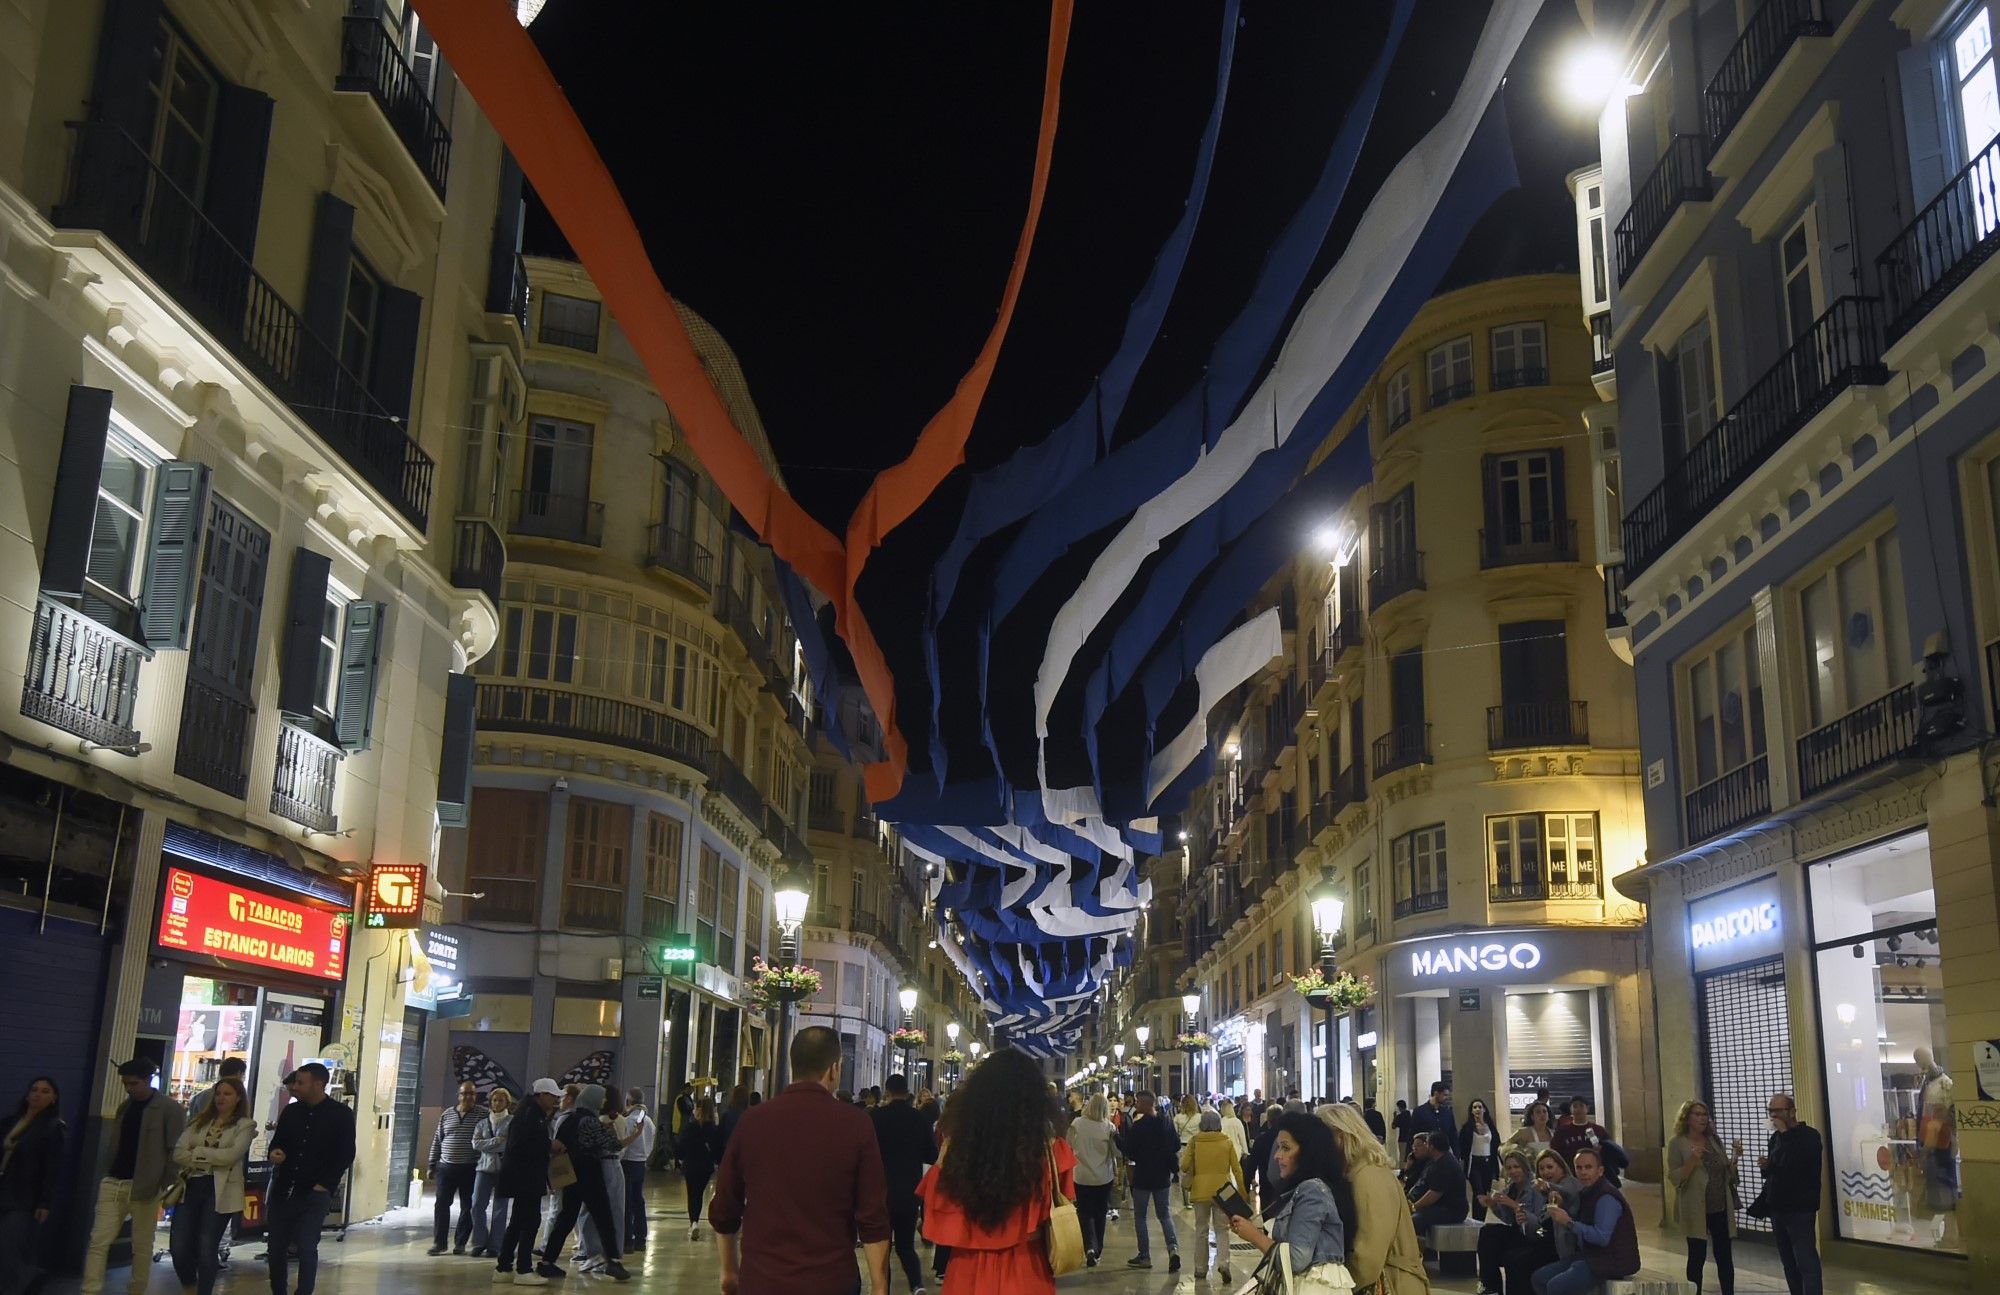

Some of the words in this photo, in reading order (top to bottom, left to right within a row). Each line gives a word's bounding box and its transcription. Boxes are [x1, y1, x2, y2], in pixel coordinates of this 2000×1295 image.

[248, 901, 303, 929] TABACOS
[203, 926, 268, 958] ESTANCO
[270, 942, 315, 968] LARIOS
[1412, 943, 1540, 976] MANGO
[1526, 1075, 1548, 1088] 24h
[1843, 1199, 1897, 1222] SUMMER
